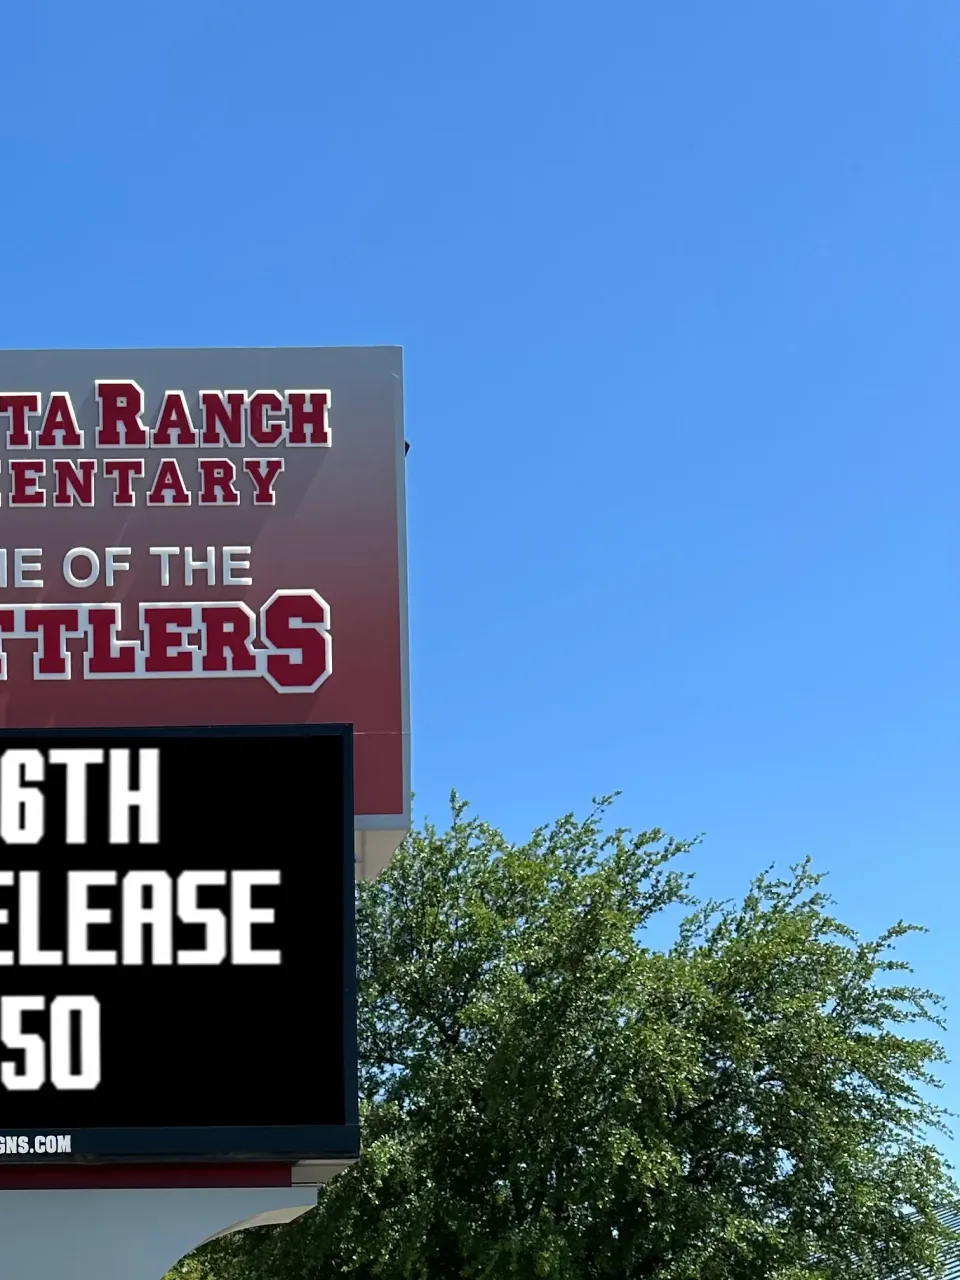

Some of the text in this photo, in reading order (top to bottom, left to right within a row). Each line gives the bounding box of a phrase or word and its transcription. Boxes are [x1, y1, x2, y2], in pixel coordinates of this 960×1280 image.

[94, 379, 332, 448] RANCH
[62, 546, 132, 588] OF
[149, 545, 253, 587] THE
